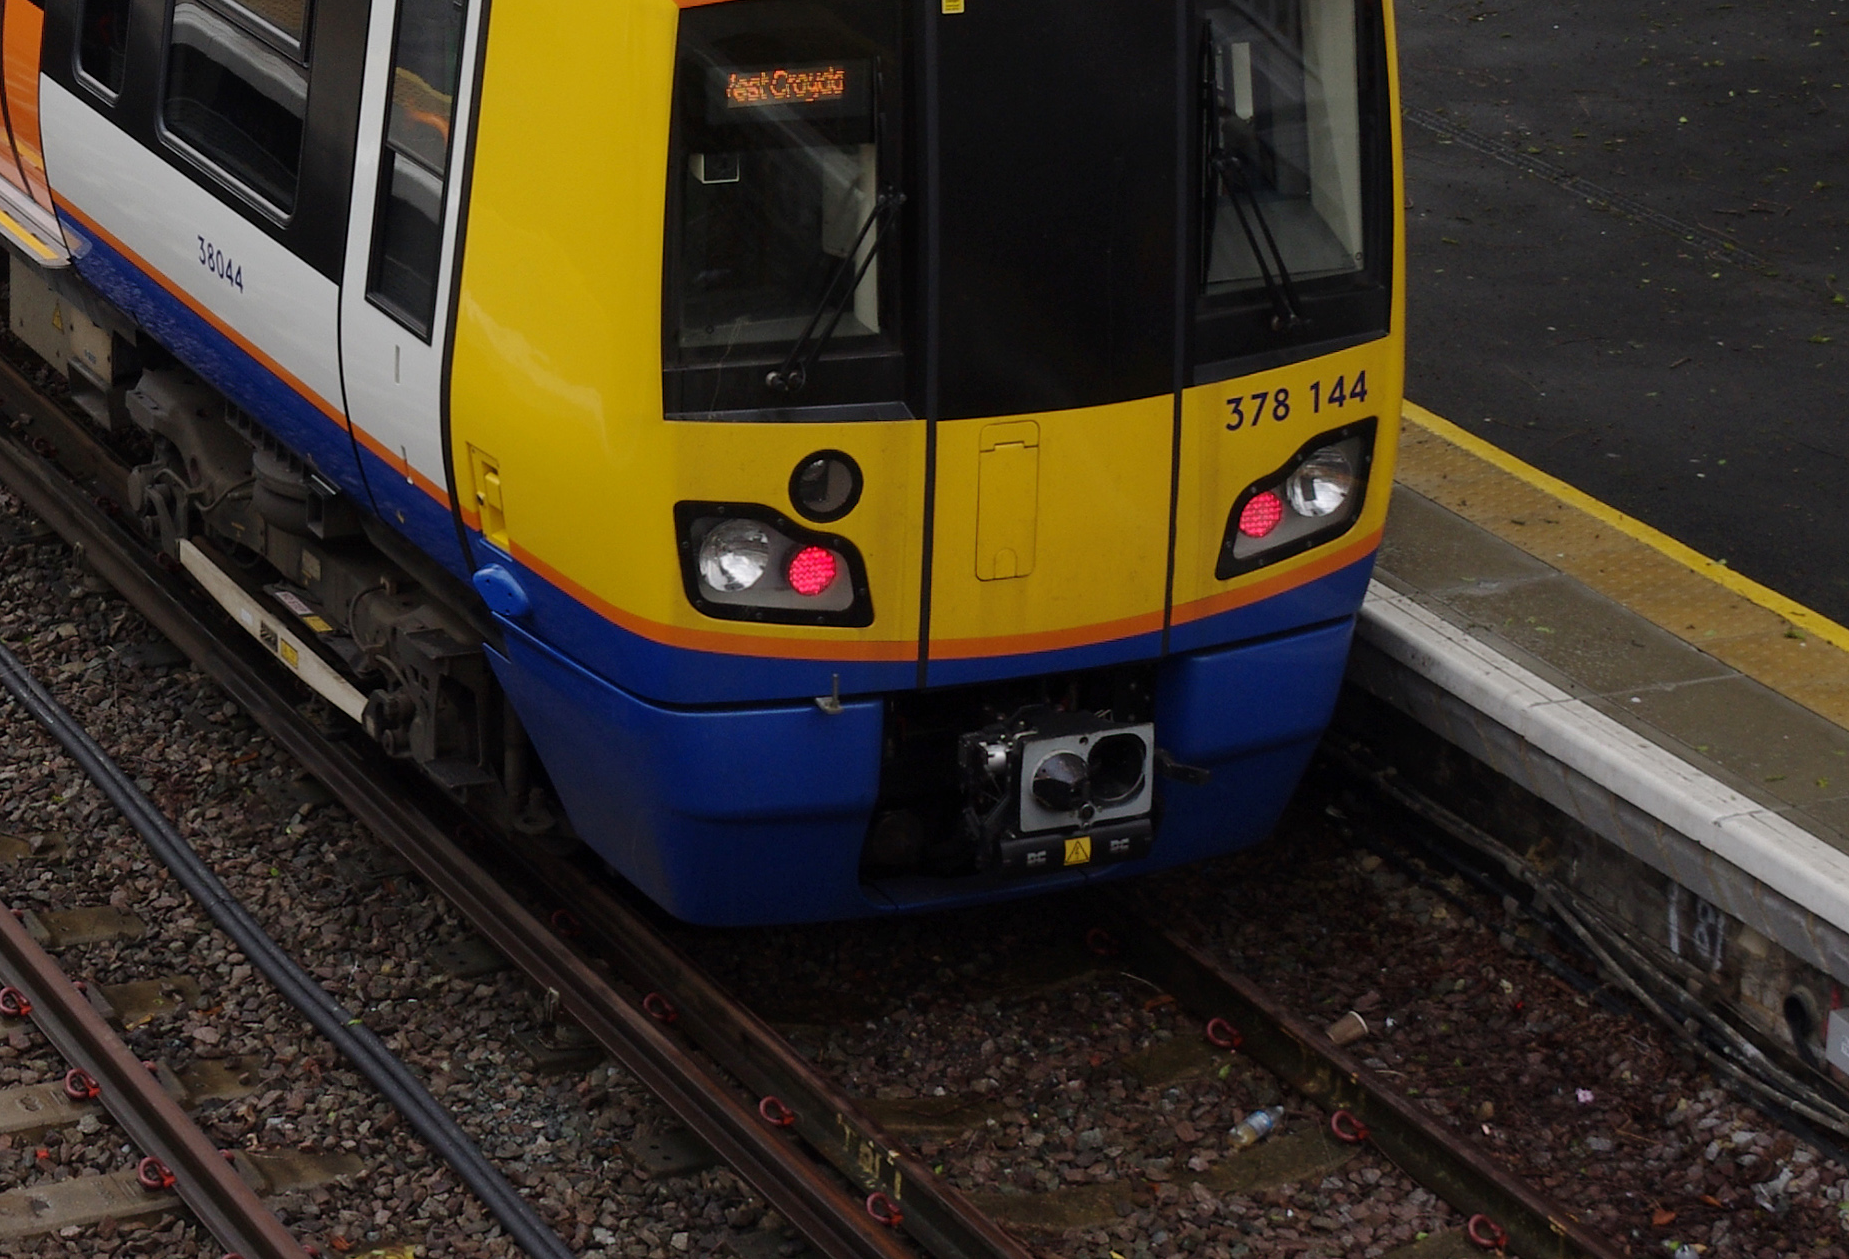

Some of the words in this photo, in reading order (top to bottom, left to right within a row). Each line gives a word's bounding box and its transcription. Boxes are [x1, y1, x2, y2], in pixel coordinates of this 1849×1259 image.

[197, 234, 243, 294] 38044
[1226, 387, 1290, 431] 378
[1310, 369, 1368, 414] 144
